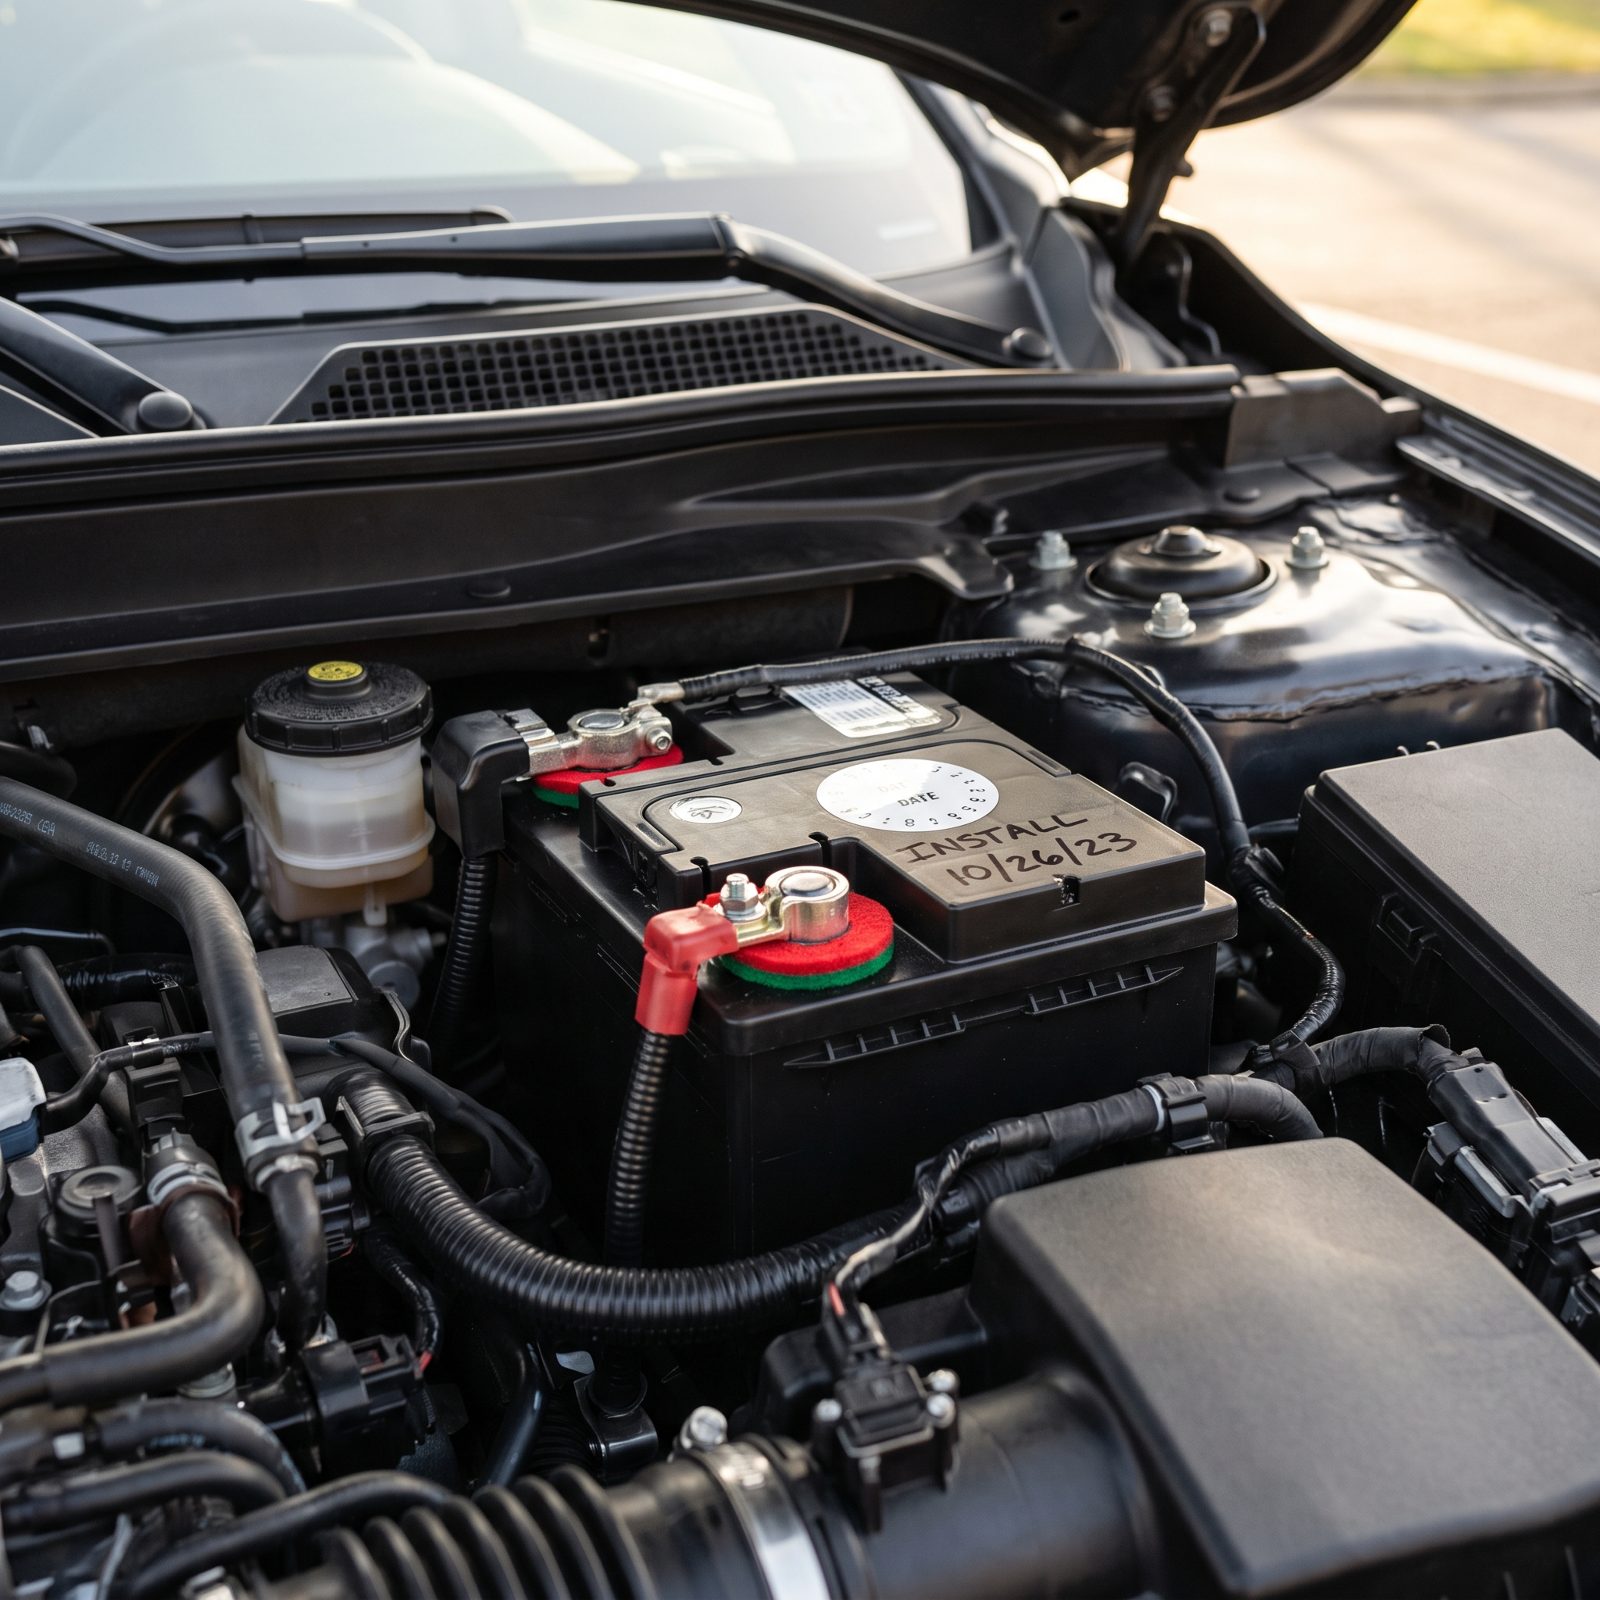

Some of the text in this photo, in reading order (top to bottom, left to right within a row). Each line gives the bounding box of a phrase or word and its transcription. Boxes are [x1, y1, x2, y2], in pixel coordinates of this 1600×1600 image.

[897, 791, 940, 807] DATE
[896, 815, 1088, 863] INSTALL
[946, 832, 1137, 886] 10/26/23
